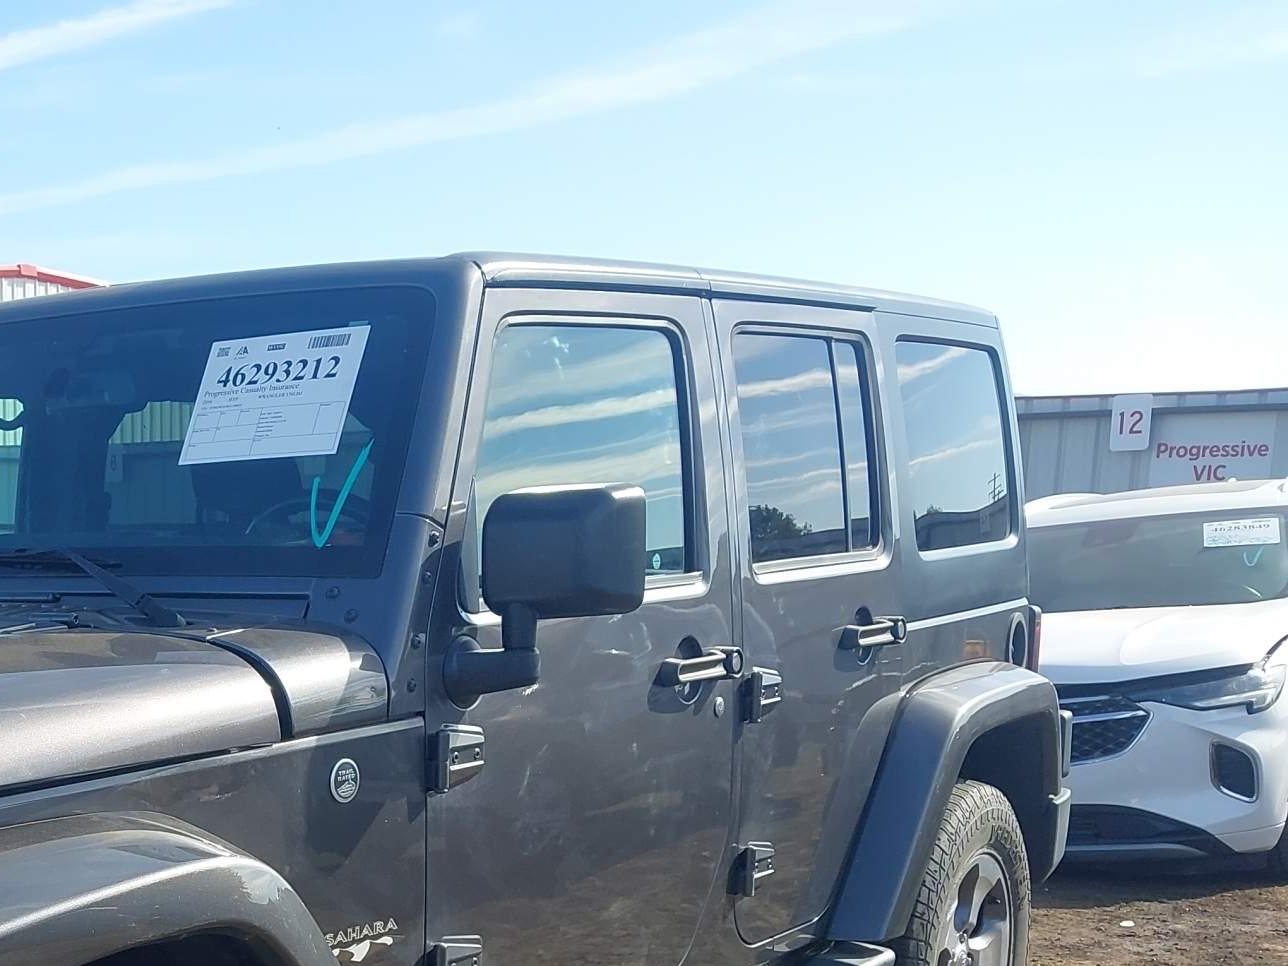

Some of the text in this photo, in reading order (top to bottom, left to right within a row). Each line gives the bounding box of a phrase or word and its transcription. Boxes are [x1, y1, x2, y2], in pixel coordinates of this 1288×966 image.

[216, 355, 342, 389] 46293212
[204, 383, 300, 399] Progressive Casualty Insurance
[1119, 410, 1144, 436] 12
[1155, 440, 1270, 461] Progressive
[1193, 464, 1227, 482] VIC
[325, 917, 399, 947] SAHARA
